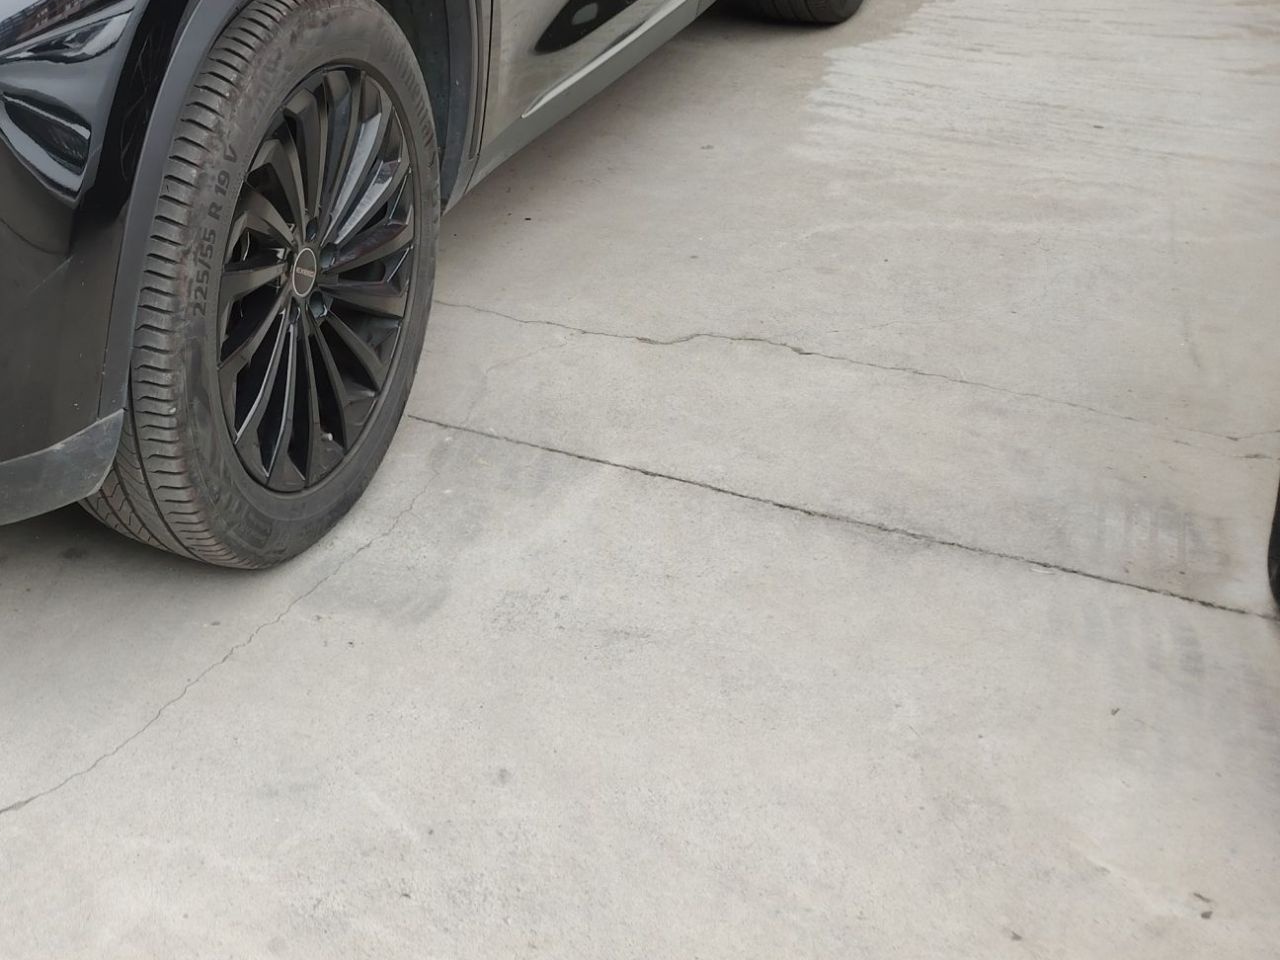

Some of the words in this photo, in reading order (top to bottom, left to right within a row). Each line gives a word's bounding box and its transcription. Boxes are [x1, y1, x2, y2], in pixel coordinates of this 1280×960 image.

[214, 169, 231, 197] 19
[208, 203, 223, 221] R
[192, 226, 217, 317] 225/55
